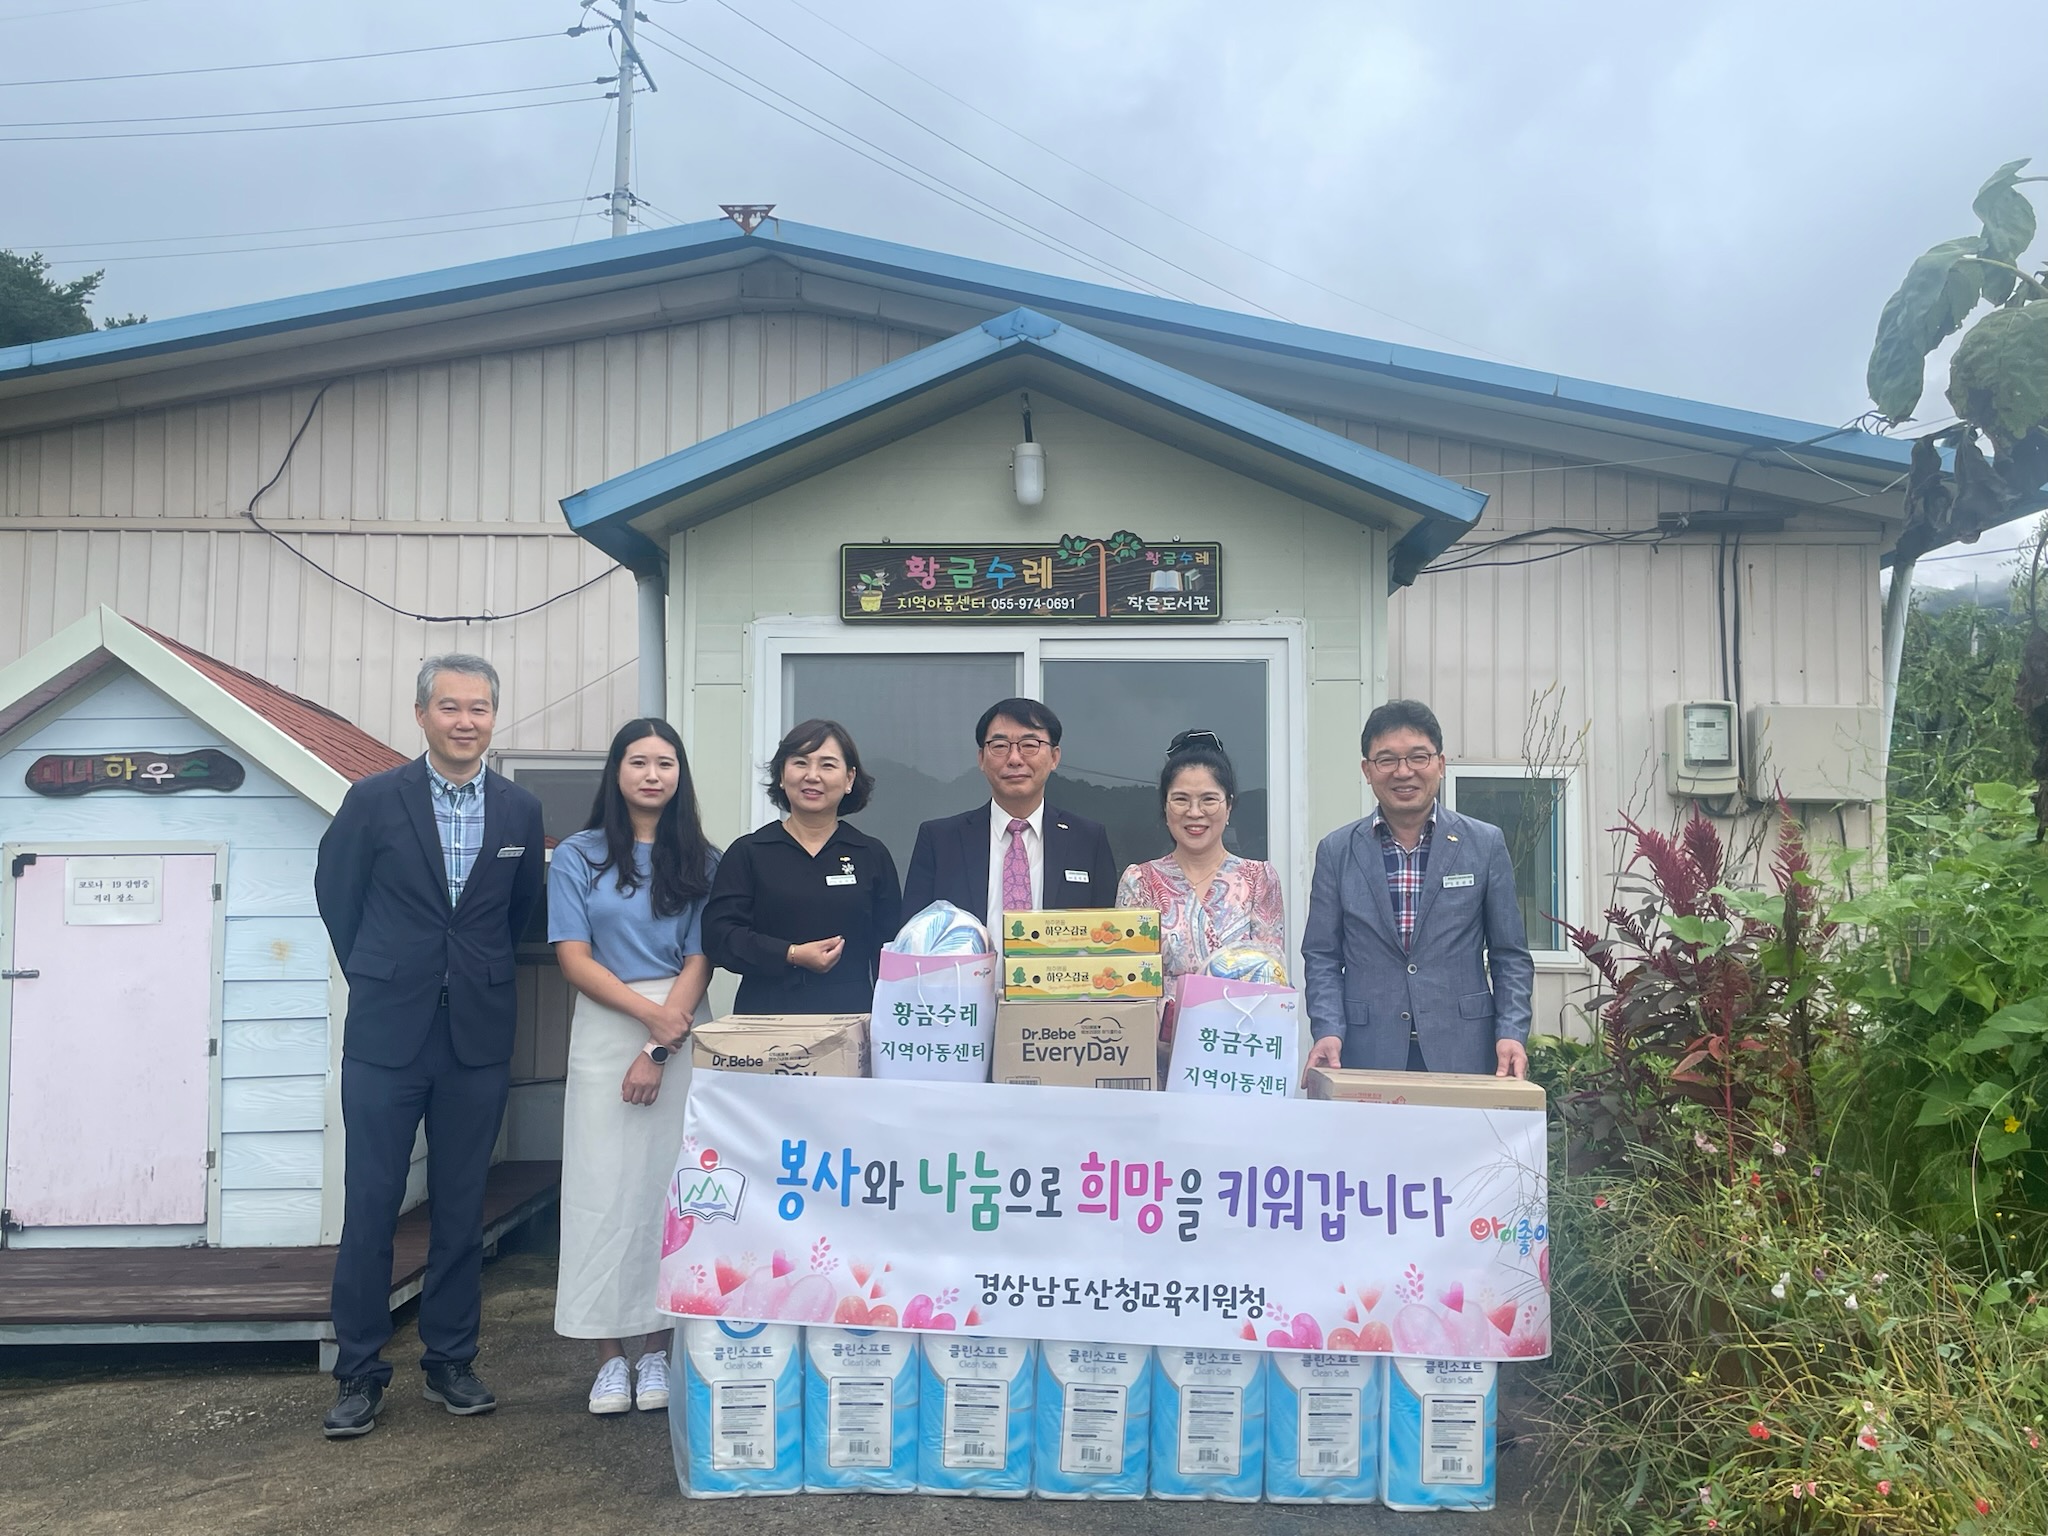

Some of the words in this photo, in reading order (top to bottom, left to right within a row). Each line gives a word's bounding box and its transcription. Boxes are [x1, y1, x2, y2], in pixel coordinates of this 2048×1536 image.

[1145, 551, 1210, 566] 황금수레
[904, 555, 1053, 590] 황금수레
[897, 595, 986, 611] 지역아동센터
[991, 597, 1076, 611] 055-974-0691
[1127, 595, 1210, 611] 작은도서관
[116, 894, 135, 903] 장소
[1045, 926, 1088, 936] 하우스감귤
[1046, 972, 1089, 982] 하우스감귤
[892, 1002, 978, 1027] 황금수레
[1022, 1028, 1076, 1040] Dr.Bebe
[1198, 1027, 1282, 1060] 황금수레
[880, 1041, 985, 1062] 지역아동센터
[1022, 1042, 1129, 1067] EveryDay
[712, 1054, 763, 1068] Dr.Bebe
[1184, 1066, 1287, 1096] 지역아동센터
[776, 1139, 904, 1221] 봉사와
[919, 1151, 1063, 1231] 나눔으로
[1077, 1151, 1203, 1242] 희망을
[1218, 1165, 1452, 1242] 키워갑니다
[975, 1273, 1266, 1319] 경상남도산청교육지원청
[714, 1346, 773, 1360] 클린소프트
[832, 1343, 891, 1357] 클린소프트
[948, 1344, 1008, 1358] 클린소프트
[1068, 1349, 1128, 1363] 클린소프트
[747, 1361, 763, 1369] Soft
[865, 1358, 881, 1367] Soft
[983, 1360, 997, 1369] Soft
[1183, 1351, 1242, 1365] 클린소프트
[1301, 1353, 1360, 1367] 클린소프트
[1101, 1366, 1117, 1374] Soft
[1217, 1367, 1232, 1376] Soft
[1334, 1369, 1349, 1378] Soft
[1424, 1360, 1484, 1373] 클린소프트
[1458, 1376, 1473, 1385] Soft
